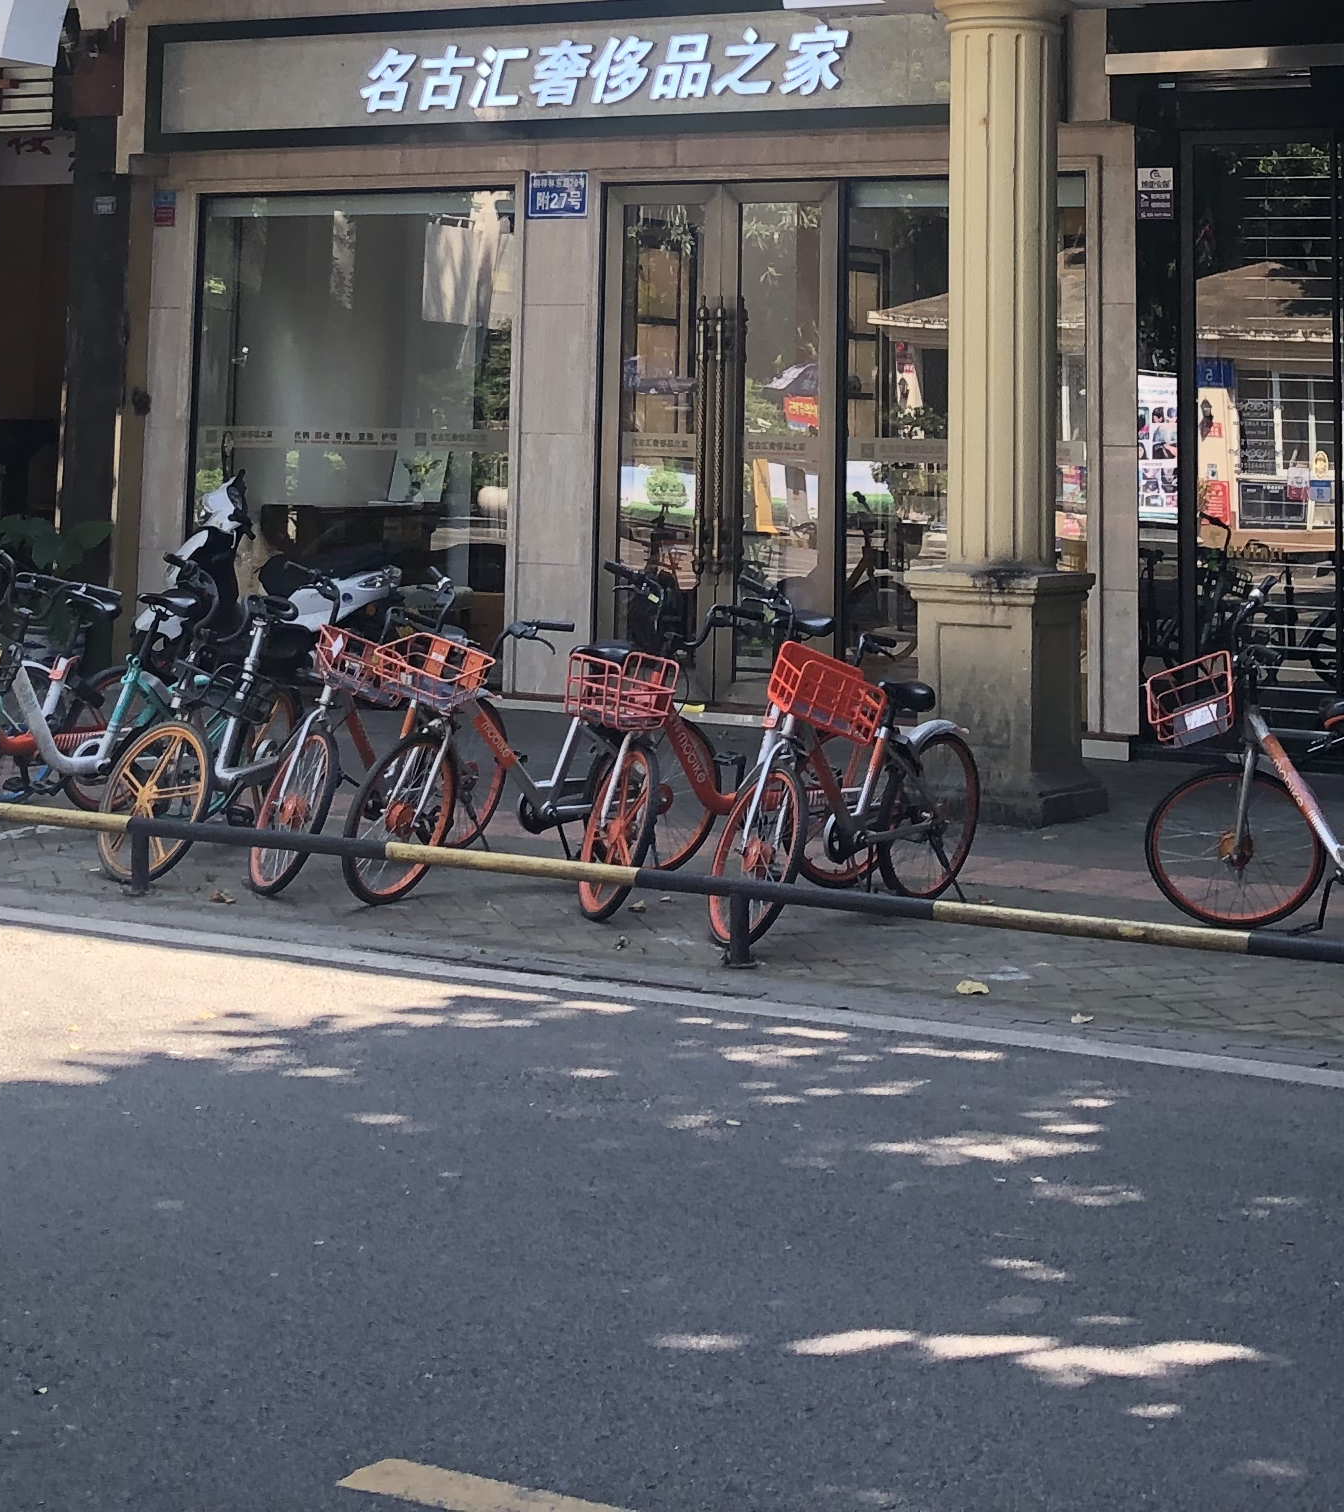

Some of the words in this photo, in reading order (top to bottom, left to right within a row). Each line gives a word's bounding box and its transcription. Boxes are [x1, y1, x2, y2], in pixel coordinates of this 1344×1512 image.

[359, 24, 850, 115] 名古汇奢侈品之家
[536, 191, 582, 210] 附27号
[677, 732, 706, 784] mobike
